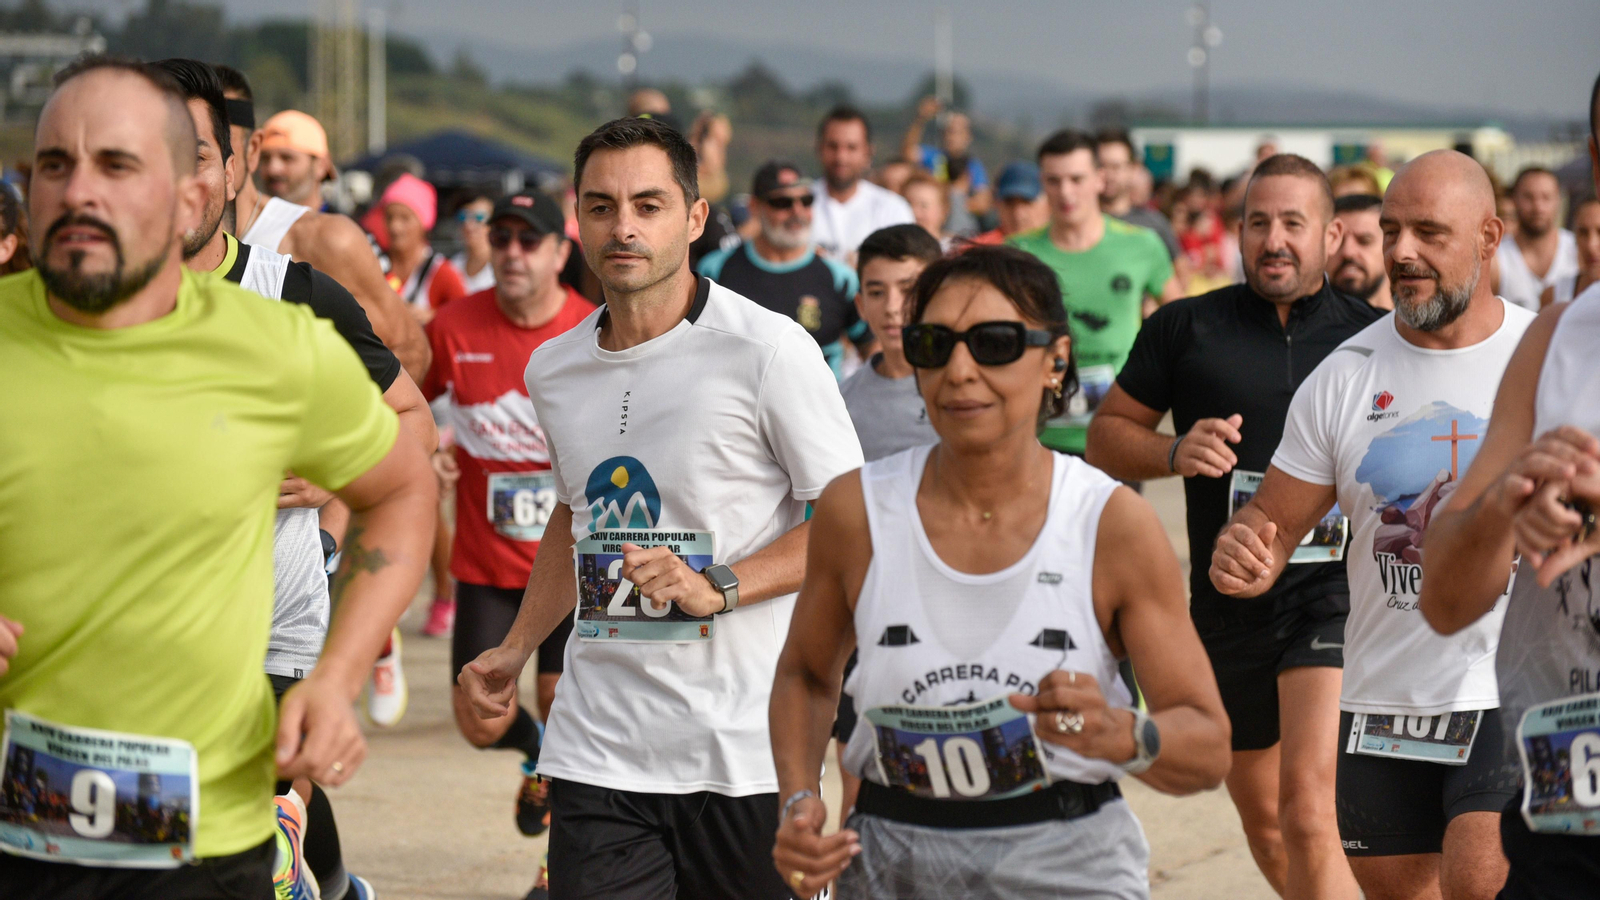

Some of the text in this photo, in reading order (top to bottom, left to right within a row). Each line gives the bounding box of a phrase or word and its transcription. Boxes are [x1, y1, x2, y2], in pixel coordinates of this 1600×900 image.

[620, 391, 631, 435] KIPSTA
[513, 488, 558, 527] 63
[590, 532, 696, 541] XXIV CARRERA POPULAR
[602, 544, 622, 553] VIRG
[1378, 553, 1422, 595] Vive
[1387, 596, 1411, 611] Cruz
[902, 664, 1036, 704] CARRERA PO
[957, 717, 989, 731] PILAR
[914, 736, 991, 798] 10
[69, 769, 117, 839] 9
